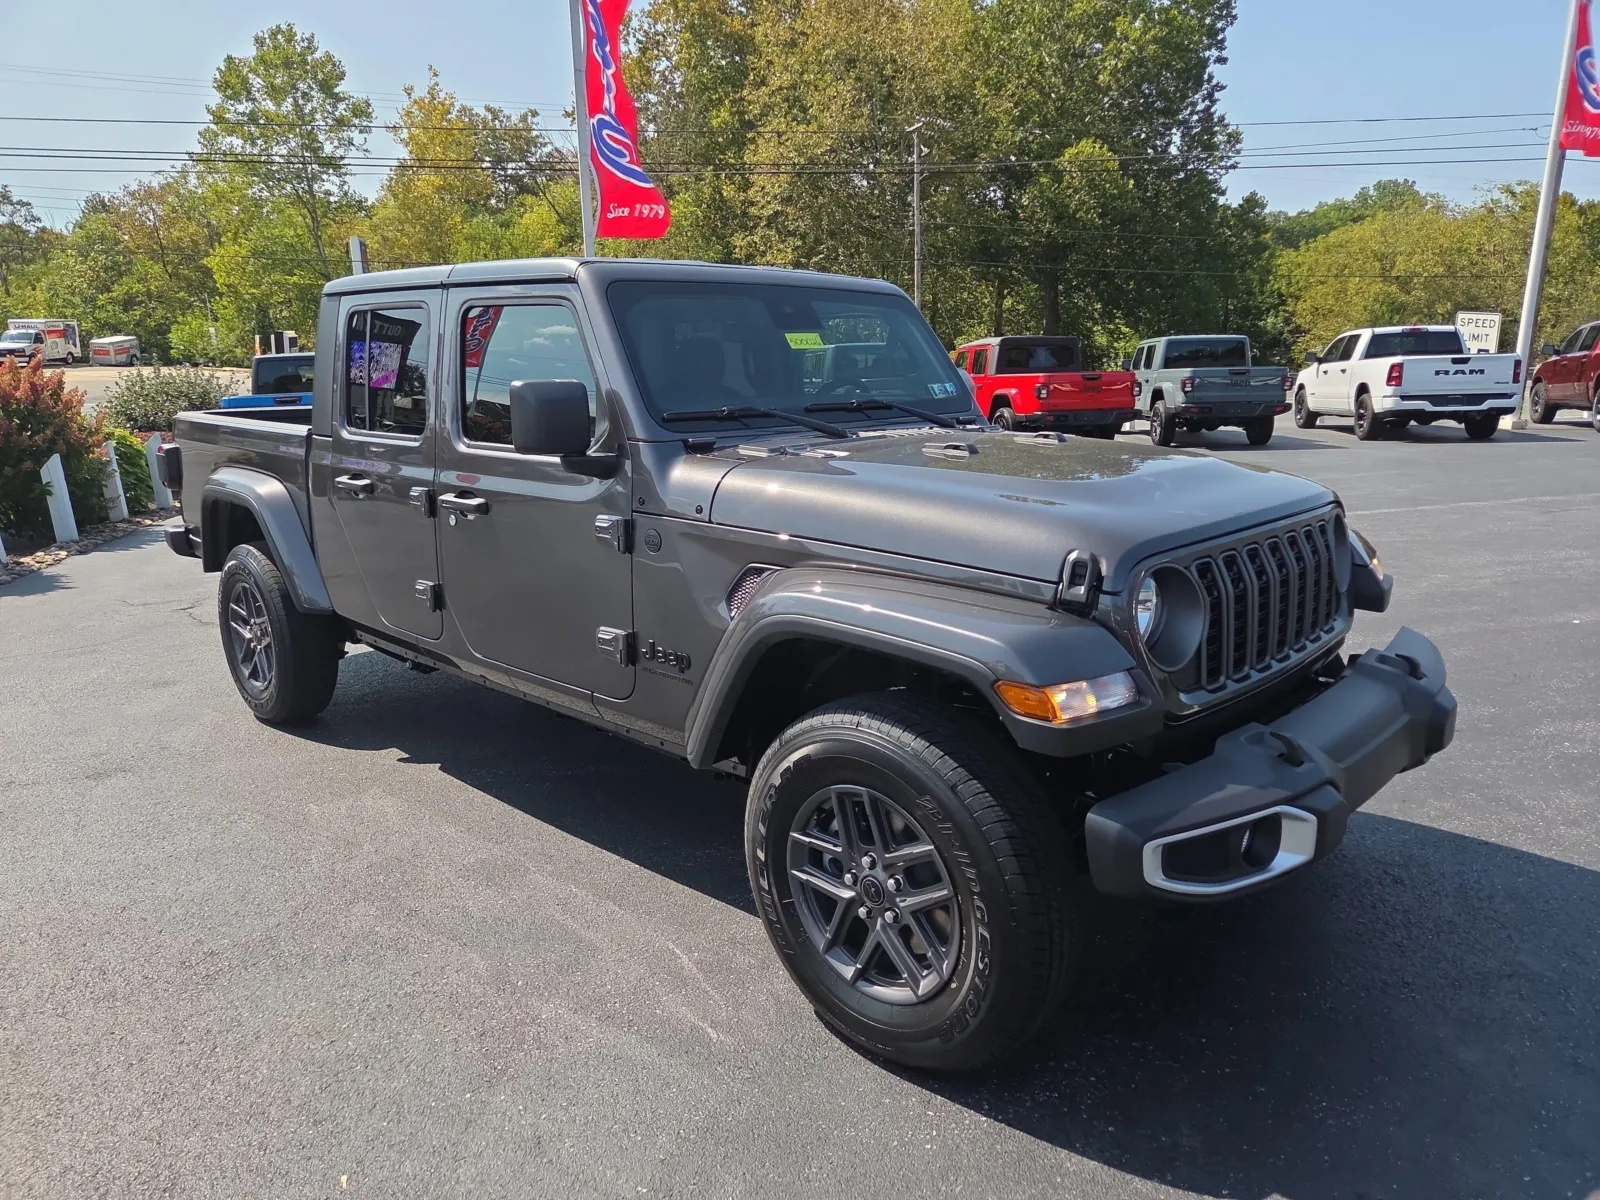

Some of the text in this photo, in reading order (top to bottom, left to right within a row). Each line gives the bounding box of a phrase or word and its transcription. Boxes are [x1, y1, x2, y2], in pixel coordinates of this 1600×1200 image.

[634, 203, 665, 219] 1979
[1460, 317, 1496, 328] SPEED
[1434, 368, 1485, 376] RAM
[641, 639, 692, 674] Jeep
